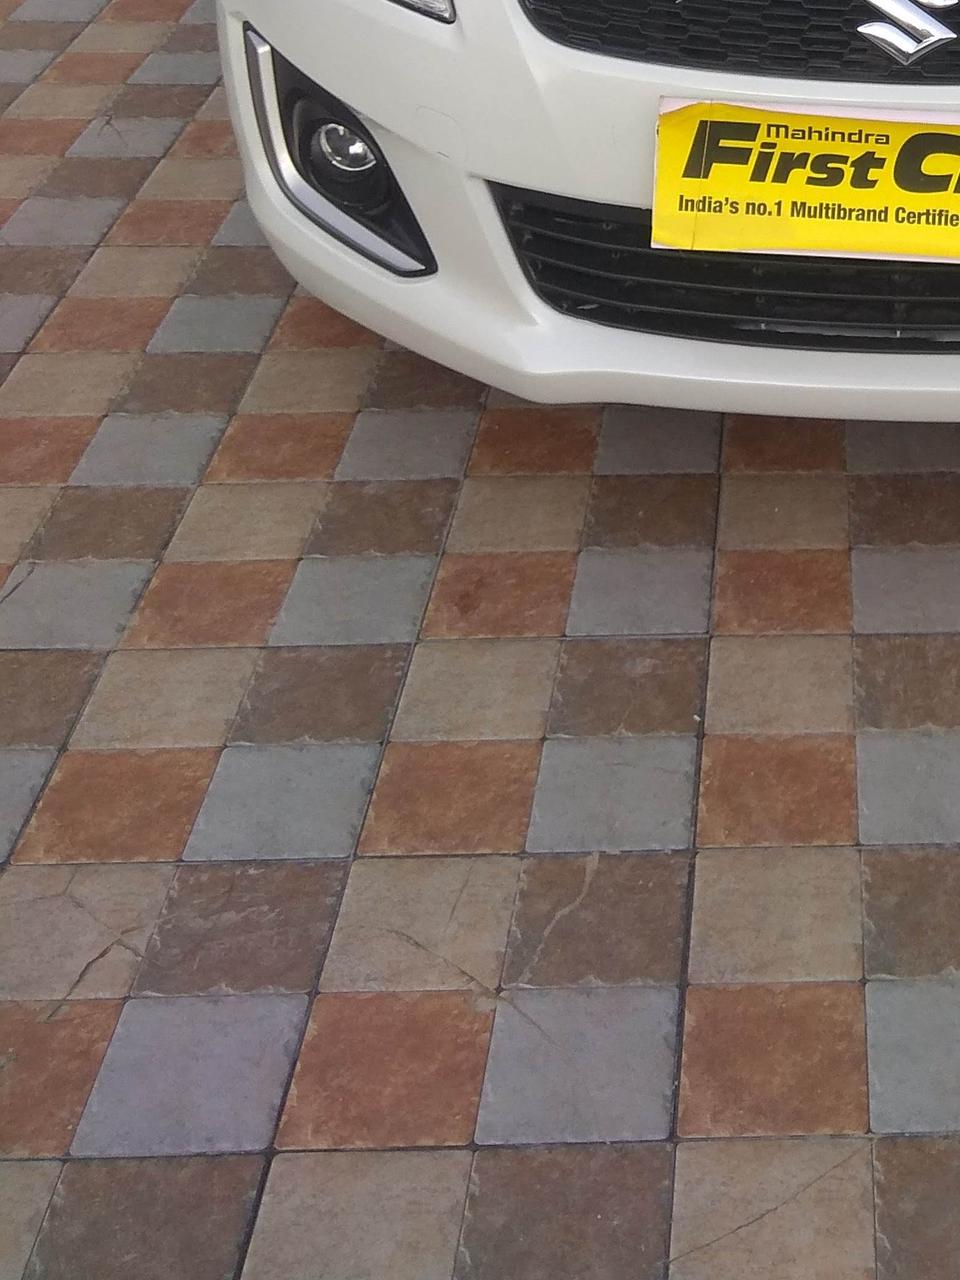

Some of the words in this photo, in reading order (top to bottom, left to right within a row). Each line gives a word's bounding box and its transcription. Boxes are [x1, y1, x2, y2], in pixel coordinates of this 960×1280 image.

[766, 124, 890, 145] Mahindra
[682, 120, 887, 189] First
[677, 194, 739, 214] India's
[745, 200, 783, 217] no.1
[790, 200, 888, 223] Multibrand
